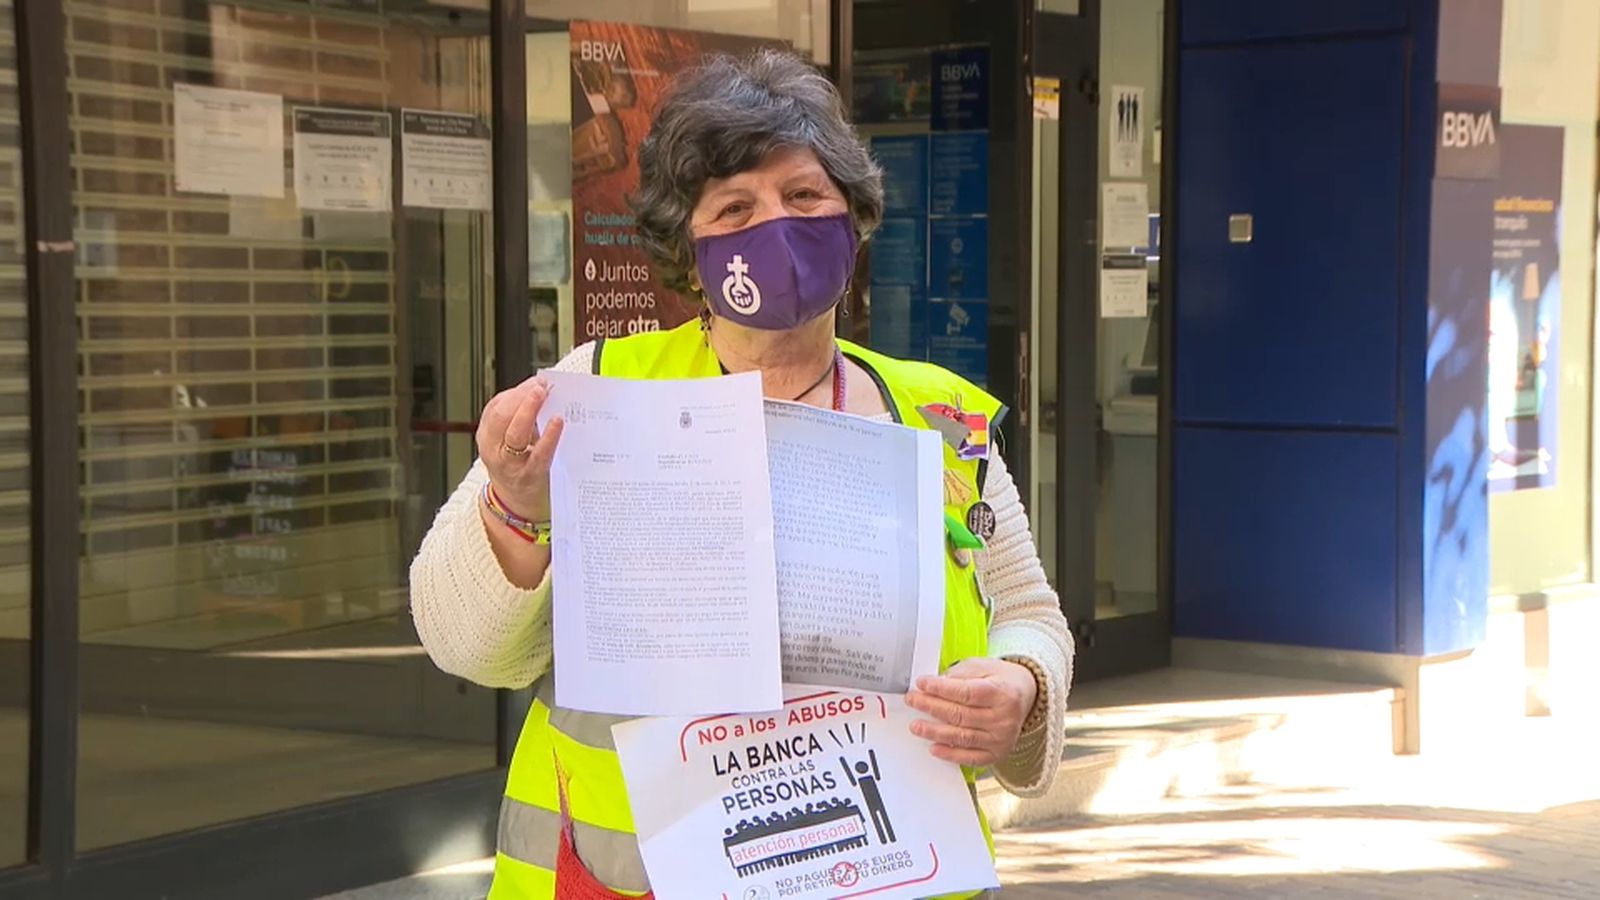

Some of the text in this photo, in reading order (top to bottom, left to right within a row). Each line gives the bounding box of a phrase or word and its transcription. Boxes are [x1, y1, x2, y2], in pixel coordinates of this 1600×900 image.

[581, 40, 626, 62] BBVA
[941, 62, 980, 81] BBVA
[1441, 110, 1496, 148] BBVA
[585, 211, 637, 227] Calculador
[585, 230, 614, 245] huella
[616, 232, 629, 245] de
[600, 260, 649, 281] Juntos
[586, 288, 656, 315] podemos
[586, 314, 660, 339] dejar otra
[698, 695, 866, 745] NO a los ABUSOS
[712, 733, 824, 776] LA BANCA
[731, 759, 816, 790] CONTRA LAS
[721, 771, 837, 815] PERSONAS
[734, 818, 860, 864] atención personal
[775, 877, 793, 889] NO
[796, 866, 843, 886] PAGUES
[871, 850, 912, 867] EUROS
[778, 886, 802, 898] POR
[871, 860, 914, 876] DINERO
